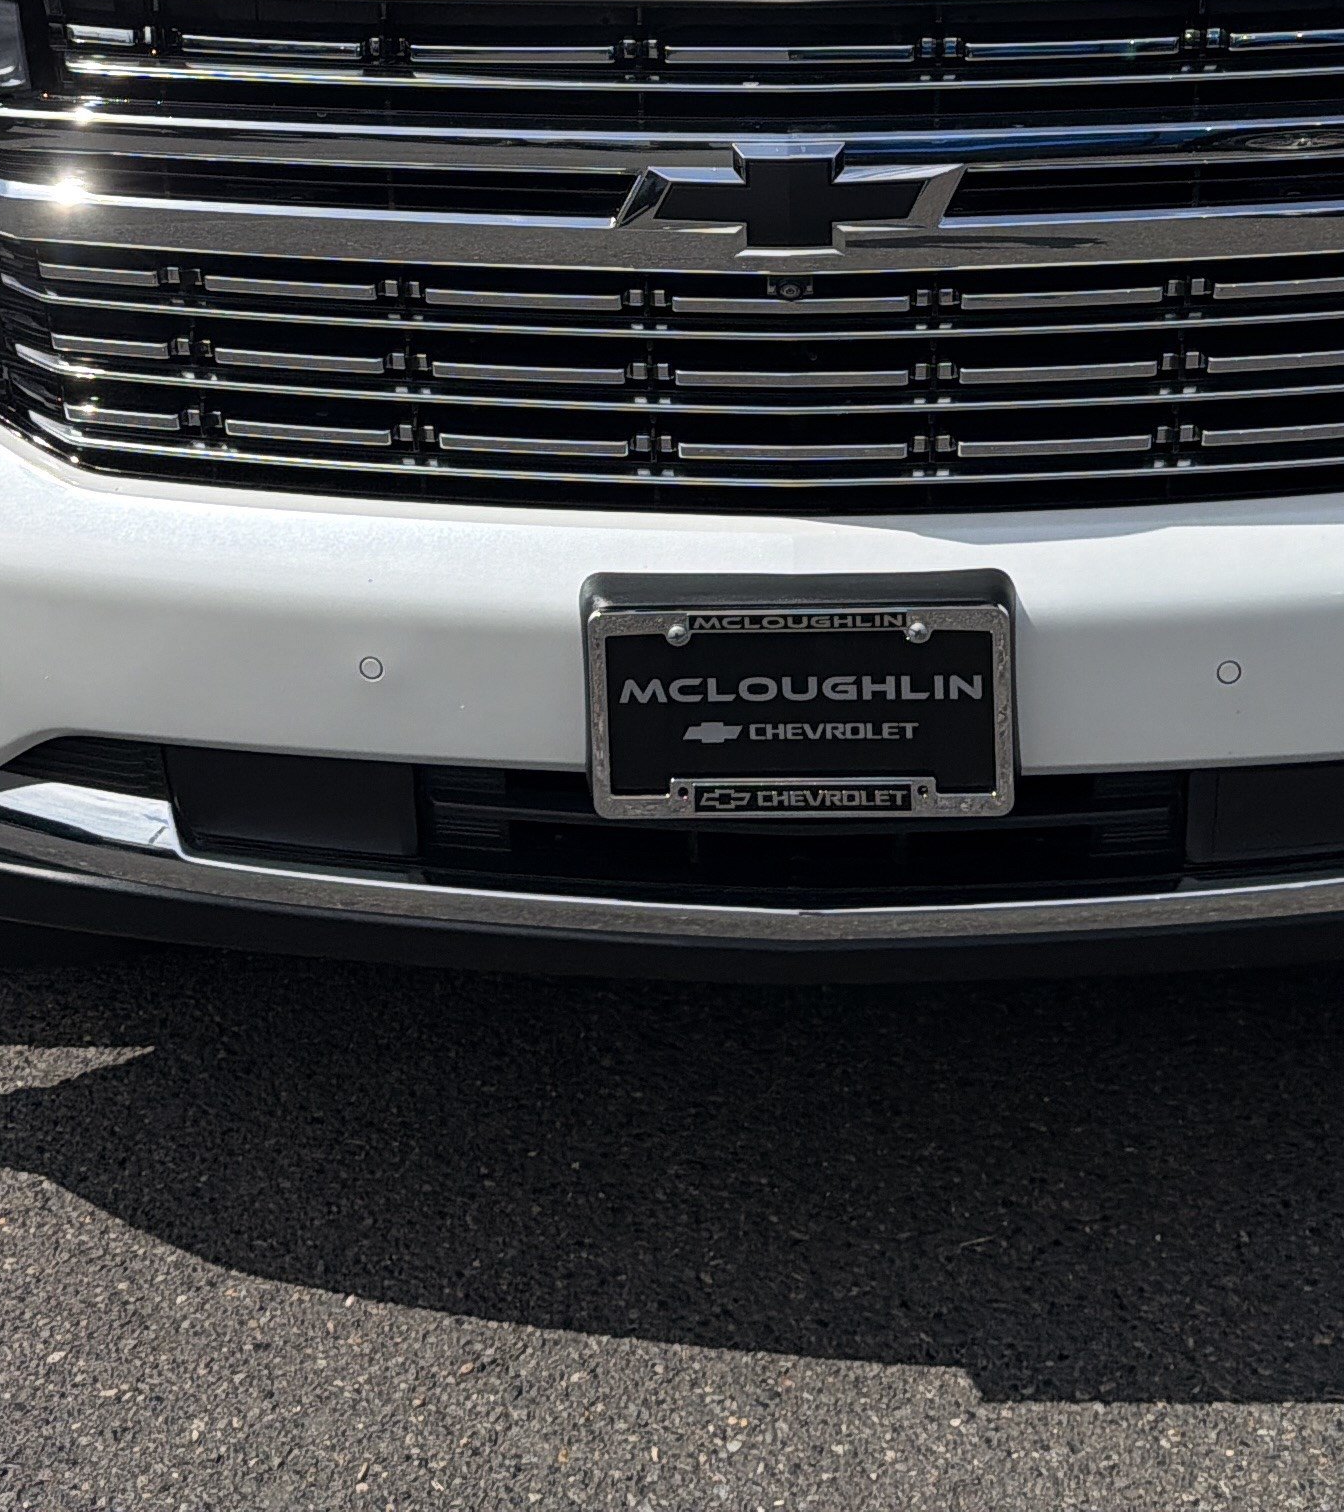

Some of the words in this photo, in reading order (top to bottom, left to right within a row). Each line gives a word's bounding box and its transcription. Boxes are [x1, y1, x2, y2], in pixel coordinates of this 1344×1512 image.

[692, 613, 905, 631] MCLOUGHLIN
[619, 674, 984, 705] MCLOUGHLIN
[749, 722, 920, 741] CHEVROLET
[757, 789, 910, 808] CHEVROLET
